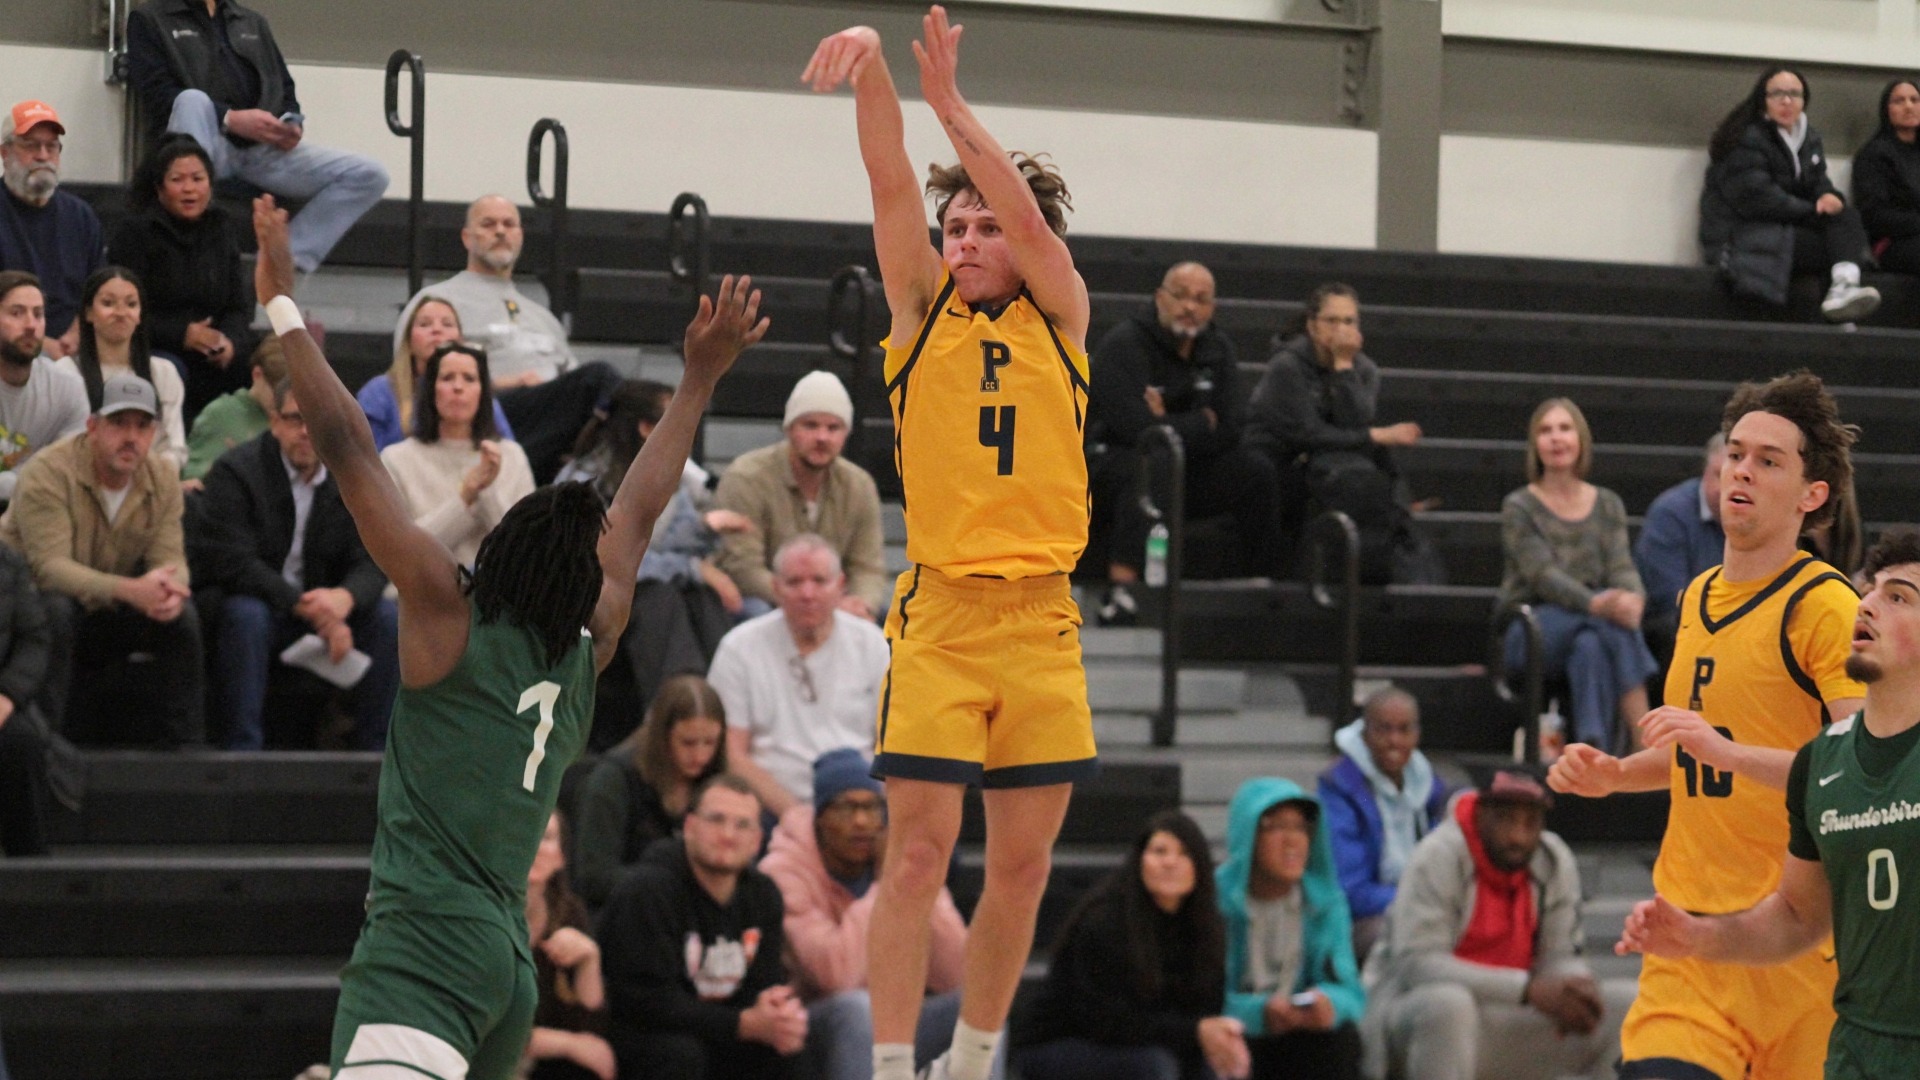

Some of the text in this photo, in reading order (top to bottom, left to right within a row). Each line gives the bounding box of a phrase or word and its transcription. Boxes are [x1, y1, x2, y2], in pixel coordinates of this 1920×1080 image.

[980, 339, 1013, 392] P
[979, 405, 1016, 476] 4
[1689, 657, 1715, 711] P
[516, 680, 561, 793] 1
[1867, 848, 1899, 910] 0
